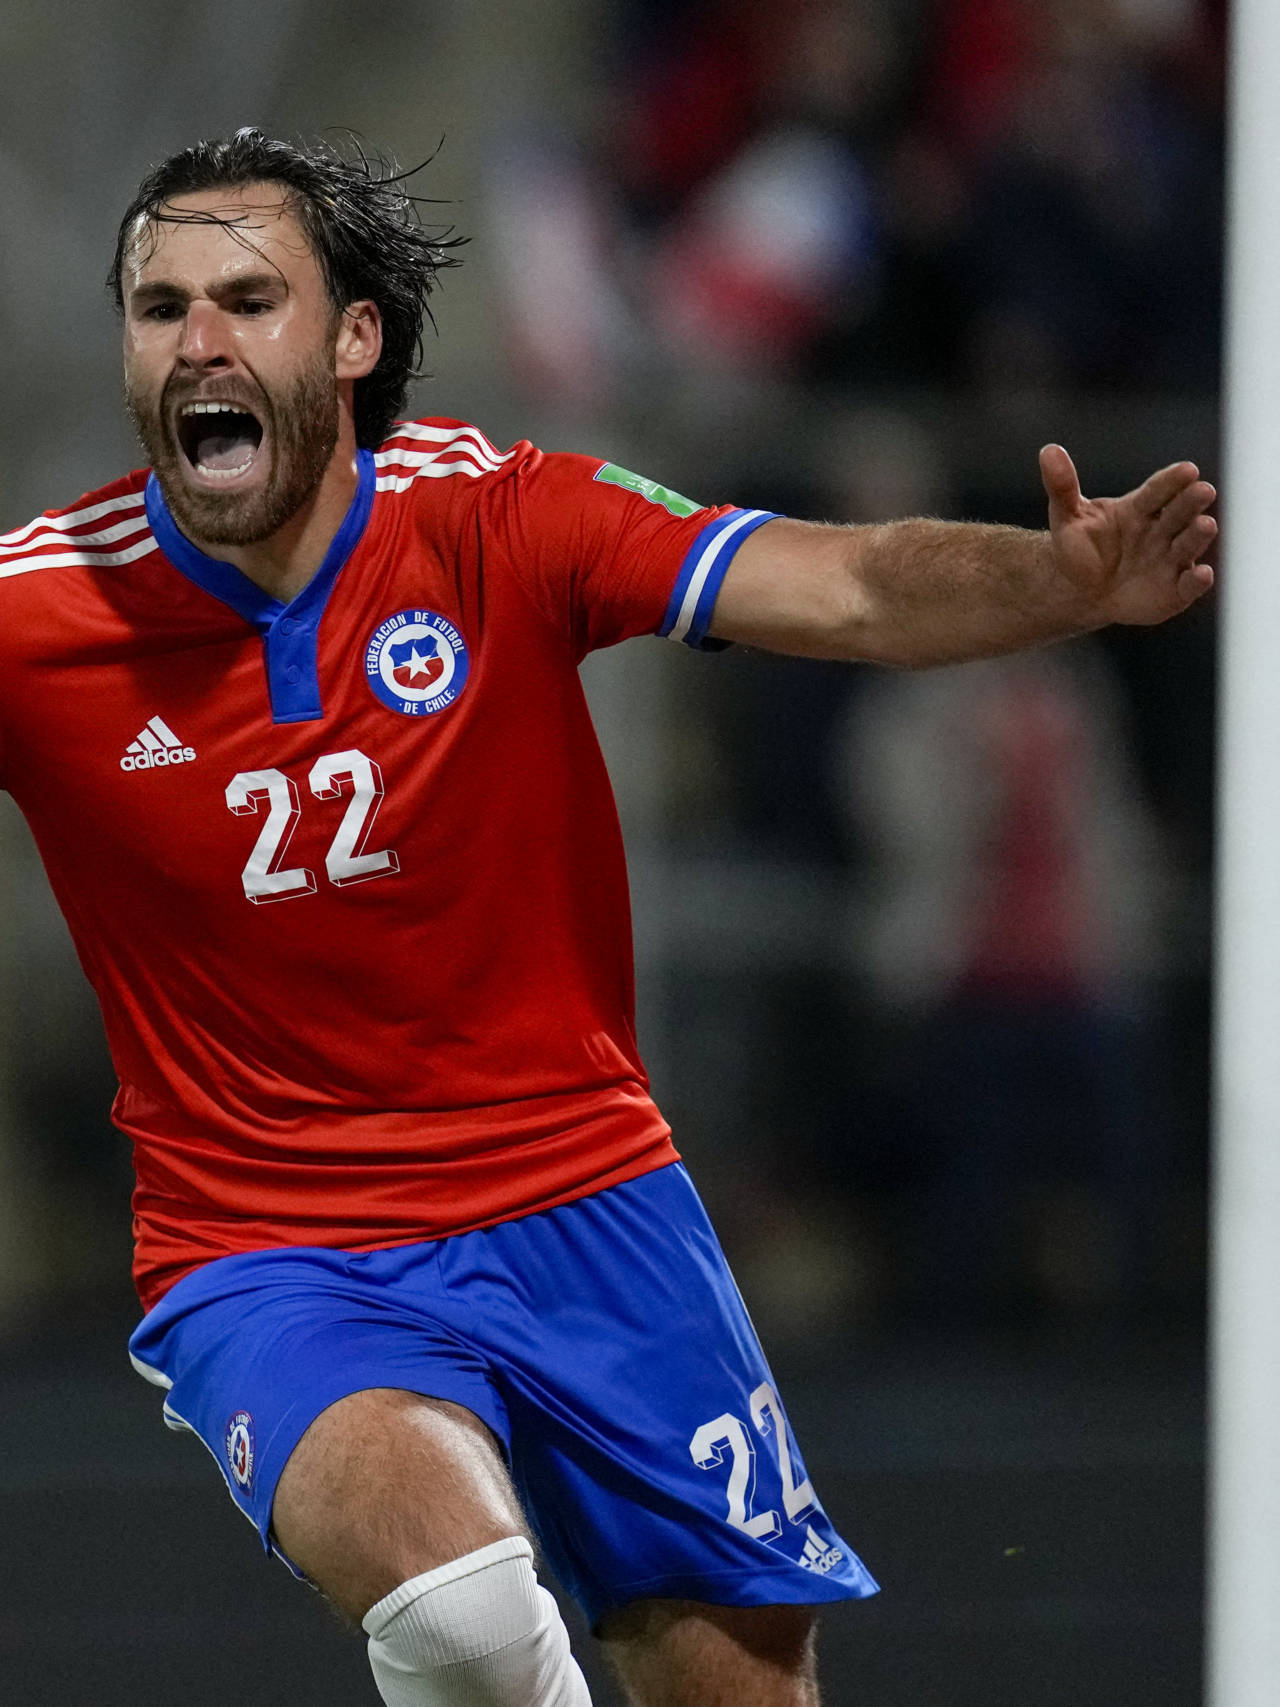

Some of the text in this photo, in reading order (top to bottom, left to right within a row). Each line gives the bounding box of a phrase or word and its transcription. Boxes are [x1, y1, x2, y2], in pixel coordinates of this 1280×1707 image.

[366, 611, 465, 676] FEDERACION DE FUTBOL
[403, 689, 455, 715] DE CHILE
[119, 747, 197, 772] adidas
[225, 749, 400, 905] 22
[689, 1381, 817, 1545] 22
